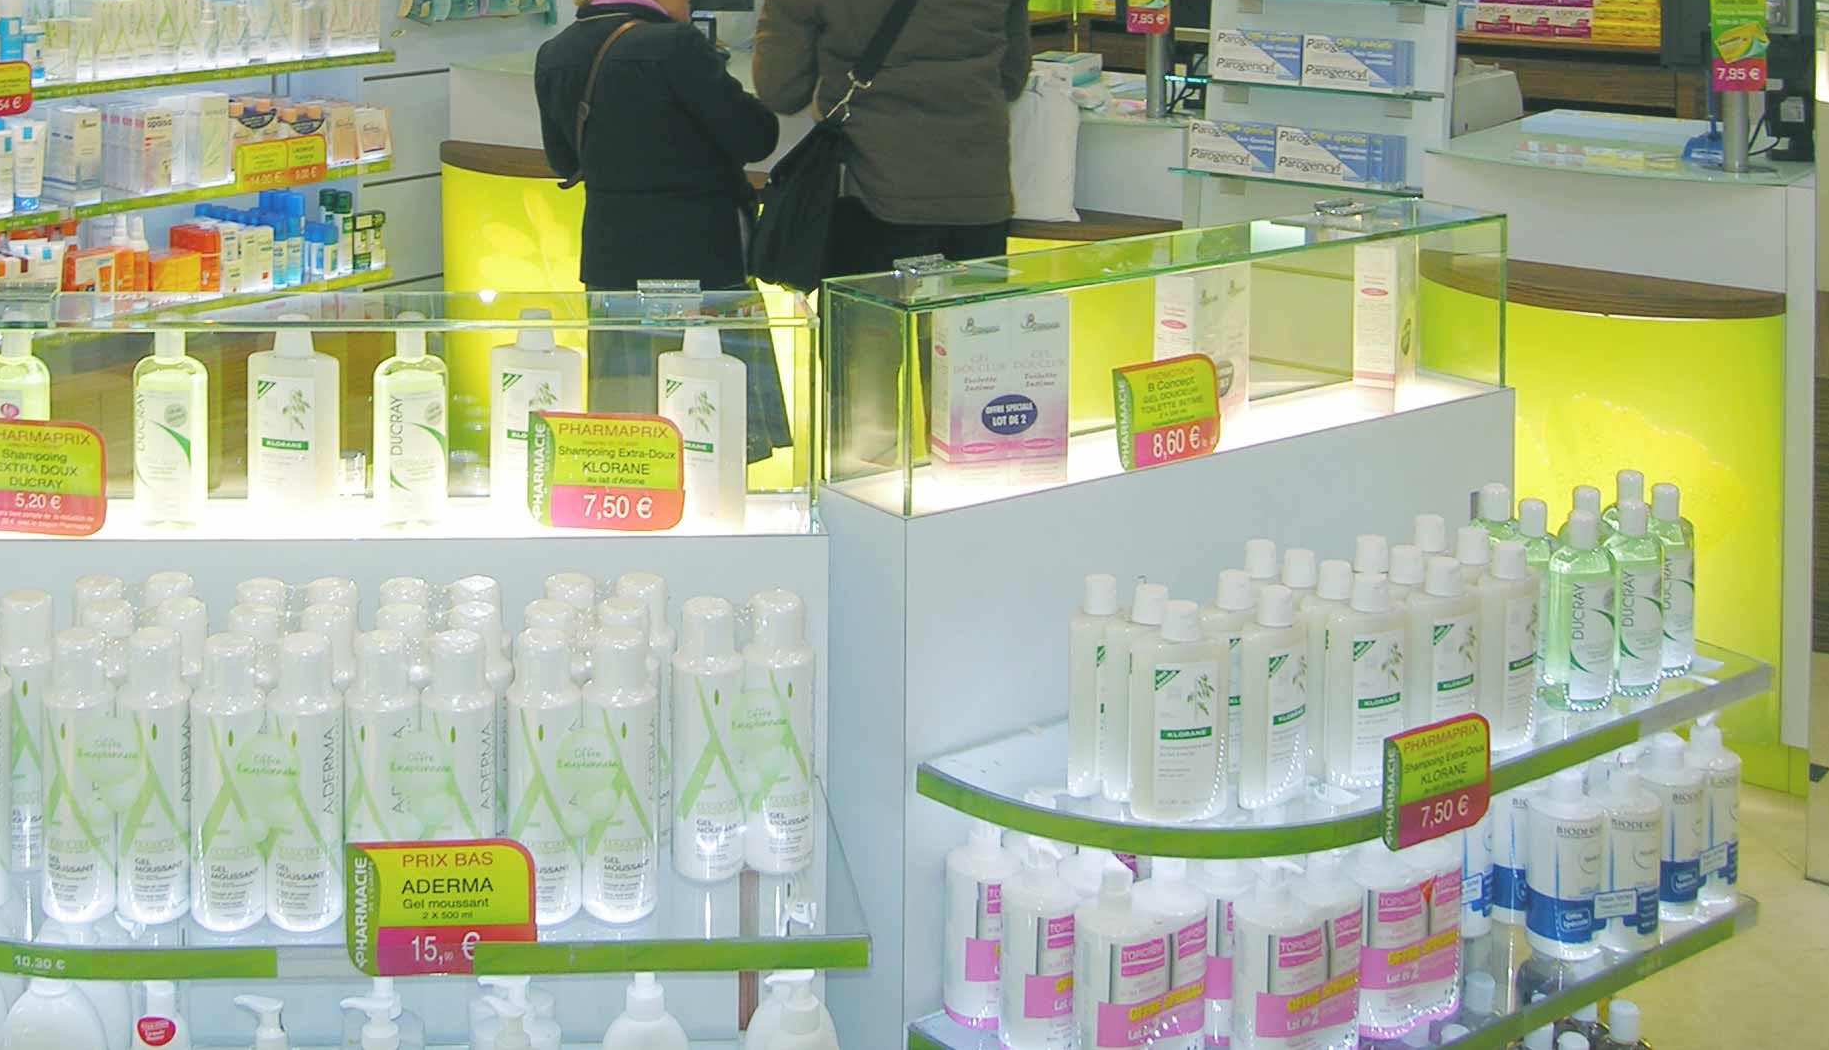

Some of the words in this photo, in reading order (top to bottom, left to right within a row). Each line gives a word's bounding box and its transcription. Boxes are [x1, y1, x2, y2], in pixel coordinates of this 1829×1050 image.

[1715, 66, 1748, 82] 7,95
[1748, 67, 1760, 81] €
[390, 394, 405, 456] DUCRAY
[992, 416, 1009, 427] LOT
[1009, 415, 1020, 426] DE
[1020, 414, 1028, 425] 2
[558, 423, 669, 440] PHARMAPRIX
[1153, 429, 1186, 461] 8,60
[1189, 425, 1201, 450] €
[2, 448, 68, 465] Shampoing
[558, 445, 616, 459] Shampoing
[618, 446, 676, 460] Extra-Doux
[40, 465, 79, 478] DOUX
[532, 422, 547, 513] PHARMACIE
[582, 461, 650, 476] KLORANE
[9, 476, 63, 490] DUCRAY
[15, 493, 47, 510] 5,20
[50, 494, 63, 511] €
[583, 494, 630, 520] 7,50
[635, 496, 654, 519] €
[1572, 582, 1584, 641] DUCRAY
[1402, 724, 1480, 753] PHARMAPRIX
[1420, 762, 1468, 785] KLORANE
[1421, 798, 1454, 829] 7,50
[1457, 794, 1470, 817] €
[402, 853, 448, 868] PRIX
[454, 851, 493, 867] BAS
[401, 877, 494, 895] ADERMA
[354, 856, 368, 957] PHARMACIE
[402, 897, 425, 910] Gel
[428, 896, 490, 909] moussant
[440, 911, 459, 920] 500
